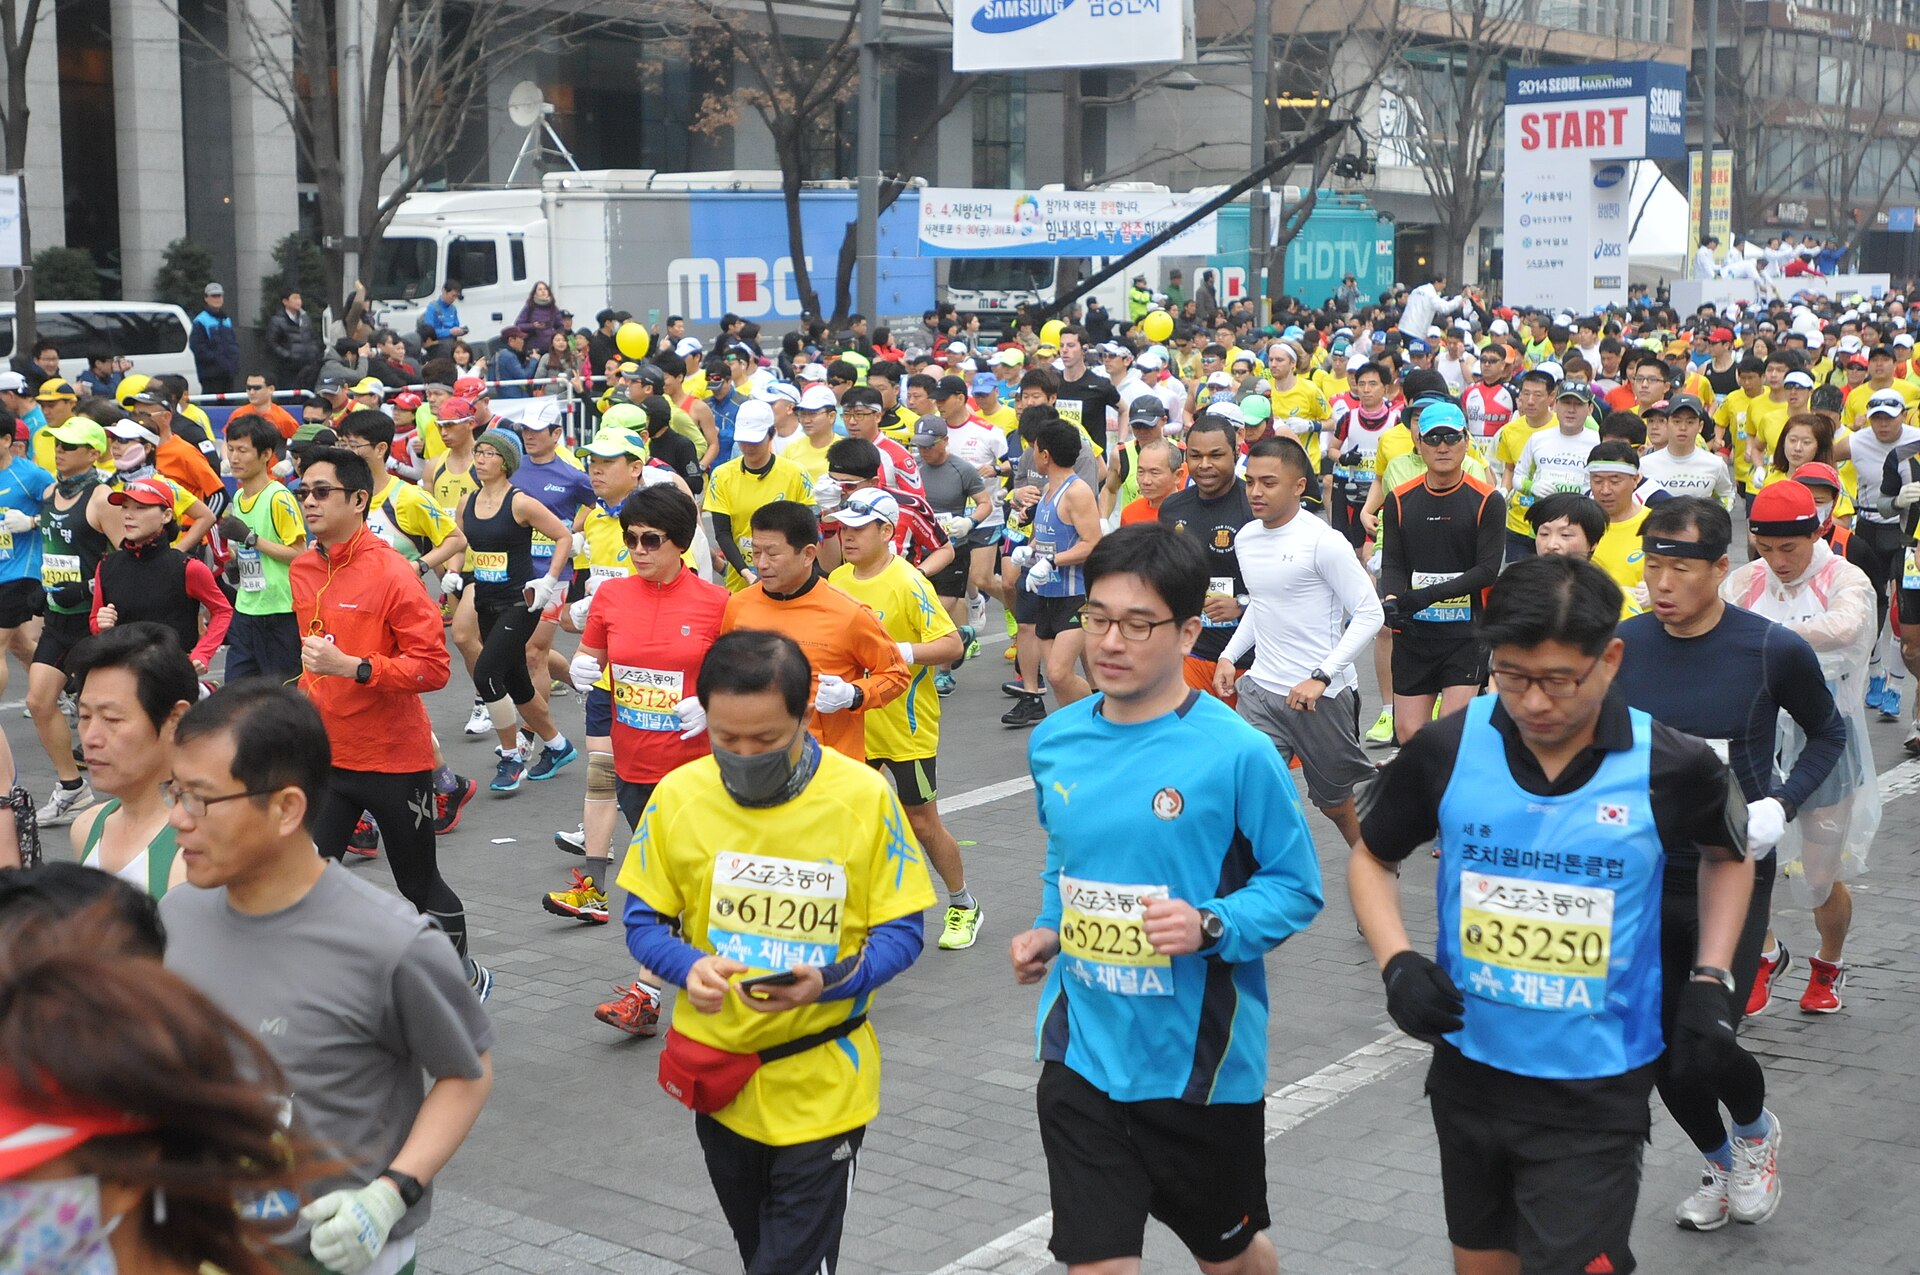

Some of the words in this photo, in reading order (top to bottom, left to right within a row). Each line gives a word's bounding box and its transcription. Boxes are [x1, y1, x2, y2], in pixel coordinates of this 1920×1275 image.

[1518, 79, 1548, 96] 2014
[1548, 76, 1582, 92] SEOUL
[1582, 76, 1632, 92] MARATHON
[1650, 86, 1682, 119] SEOUL
[1521, 107, 1628, 151] START
[1650, 119, 1680, 136] MARATHON
[1294, 240, 1371, 280] HDTV
[1377, 266, 1393, 285] HD
[668, 257, 813, 320] MBC
[977, 298, 1007, 310] MBC
[1433, 608, 1466, 620] 채널A
[620, 670, 675, 686] 스포츠동아
[625, 685, 679, 709] 35128
[635, 712, 675, 730] 채널A
[731, 862, 835, 891] 스포츠동아
[1463, 843, 1625, 878] 조치원마라톤클럽
[737, 894, 838, 934] 61204
[1478, 886, 1598, 918] 스포츠동아
[758, 939, 827, 970] 채널A
[1076, 919, 1157, 958] 5223
[1486, 920, 1603, 967] 35250
[1096, 964, 1165, 996] 채널A
[1510, 971, 1593, 1009] 채널A
